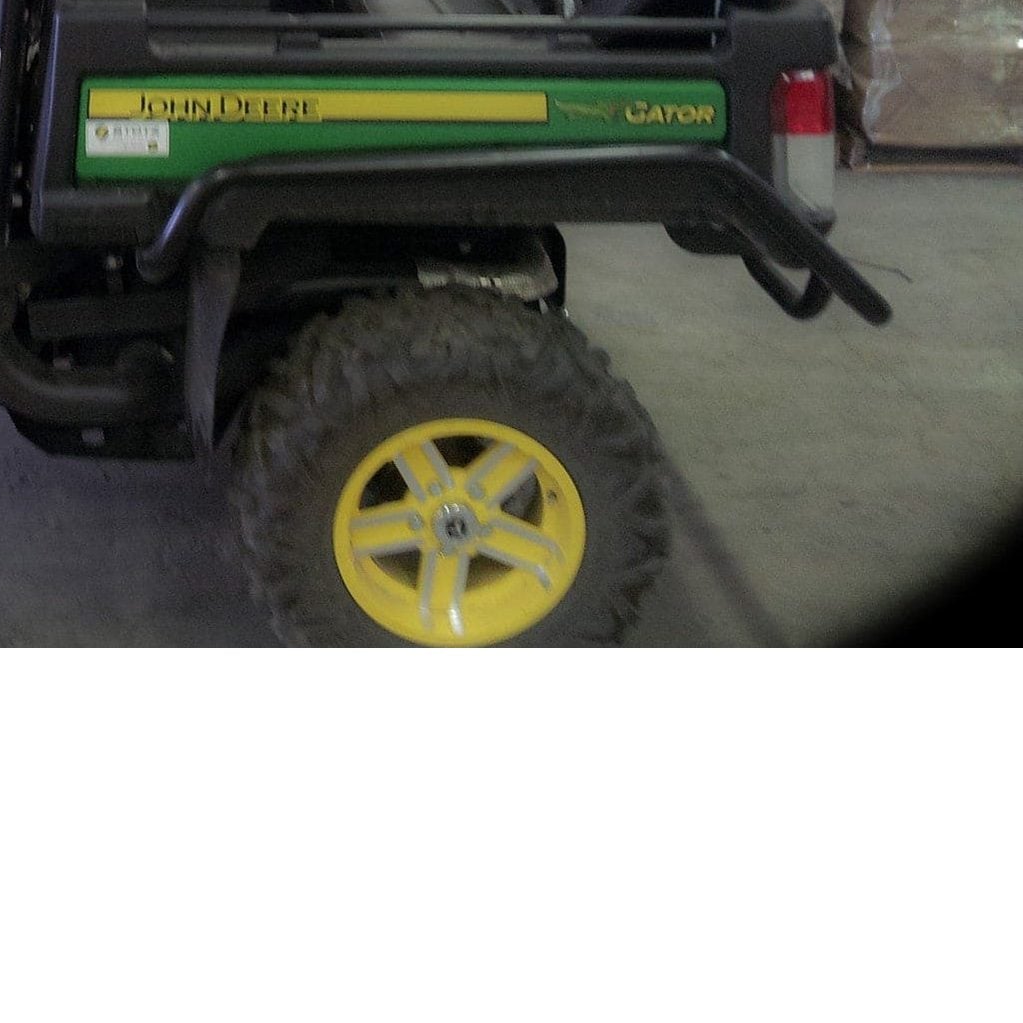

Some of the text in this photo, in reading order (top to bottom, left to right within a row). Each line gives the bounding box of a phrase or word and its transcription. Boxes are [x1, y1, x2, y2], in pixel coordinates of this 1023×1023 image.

[138, 92, 320, 117] JOHN DEERE
[625, 101, 716, 124] GATOR
